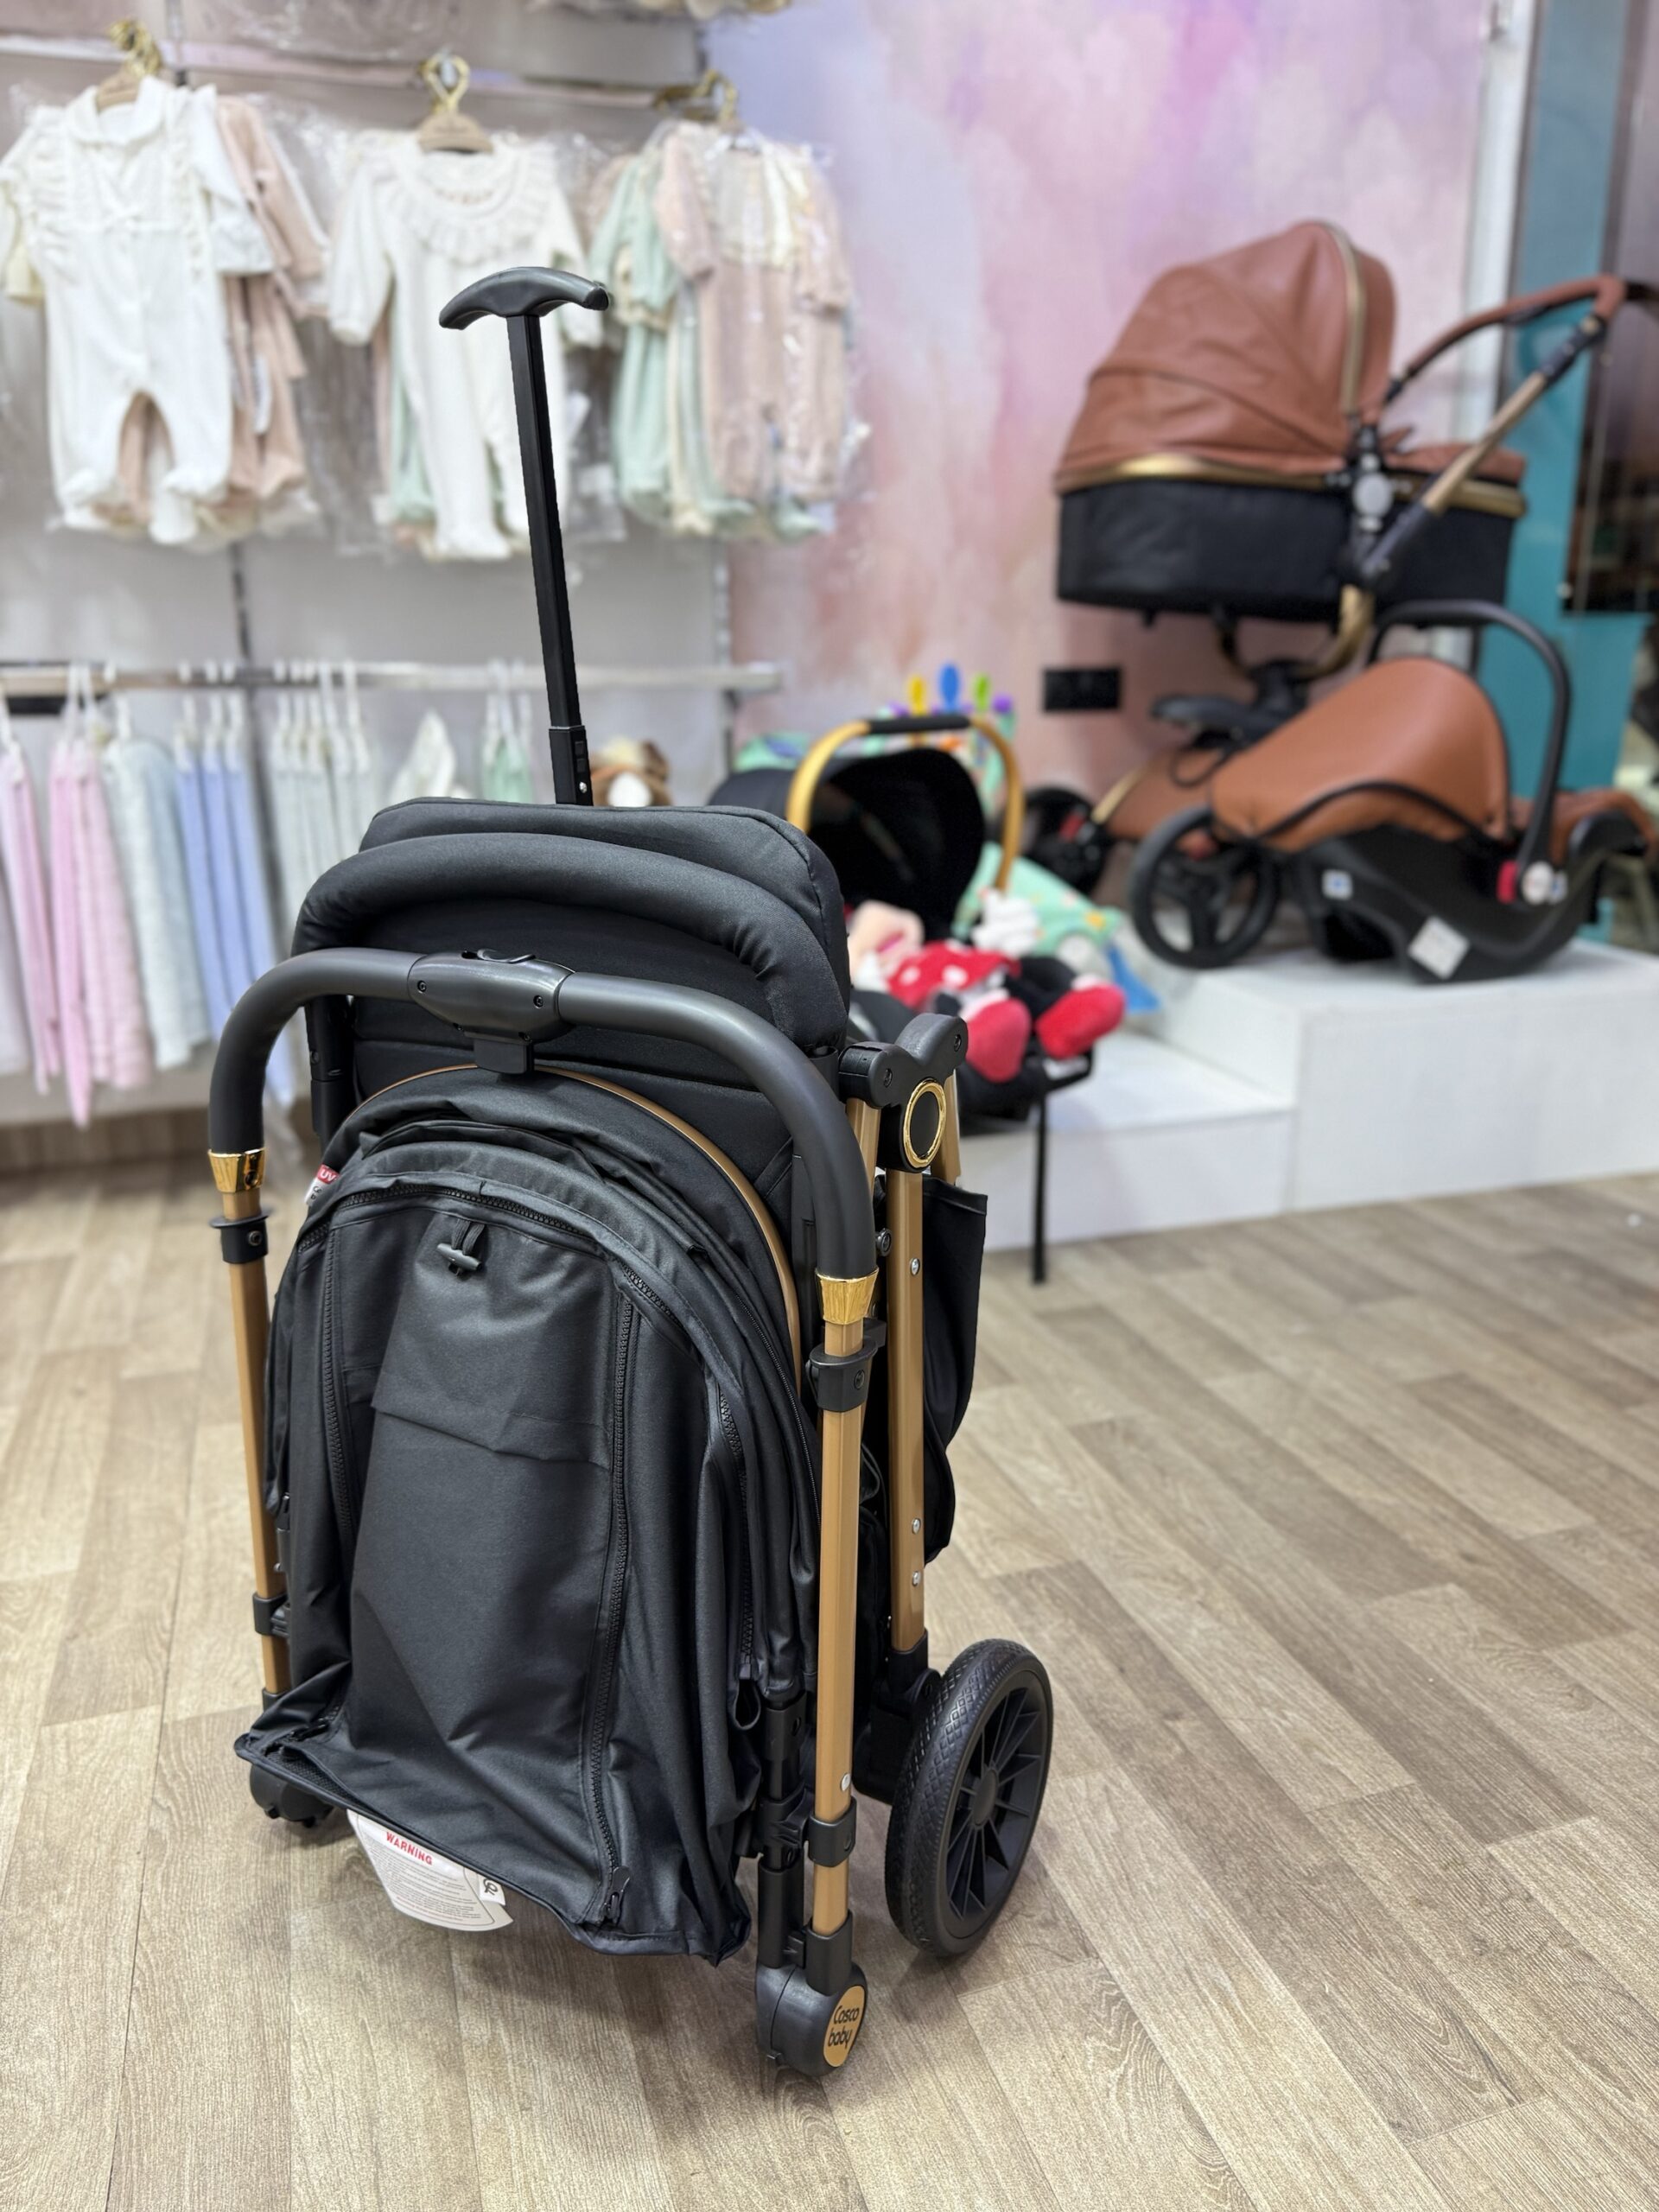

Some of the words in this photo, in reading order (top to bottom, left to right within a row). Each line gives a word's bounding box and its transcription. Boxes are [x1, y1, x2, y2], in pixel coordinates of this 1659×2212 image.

[386, 1832, 433, 1866] WARNING
[833, 2005, 860, 2024] Cosco
[828, 2026, 853, 2049] baby
